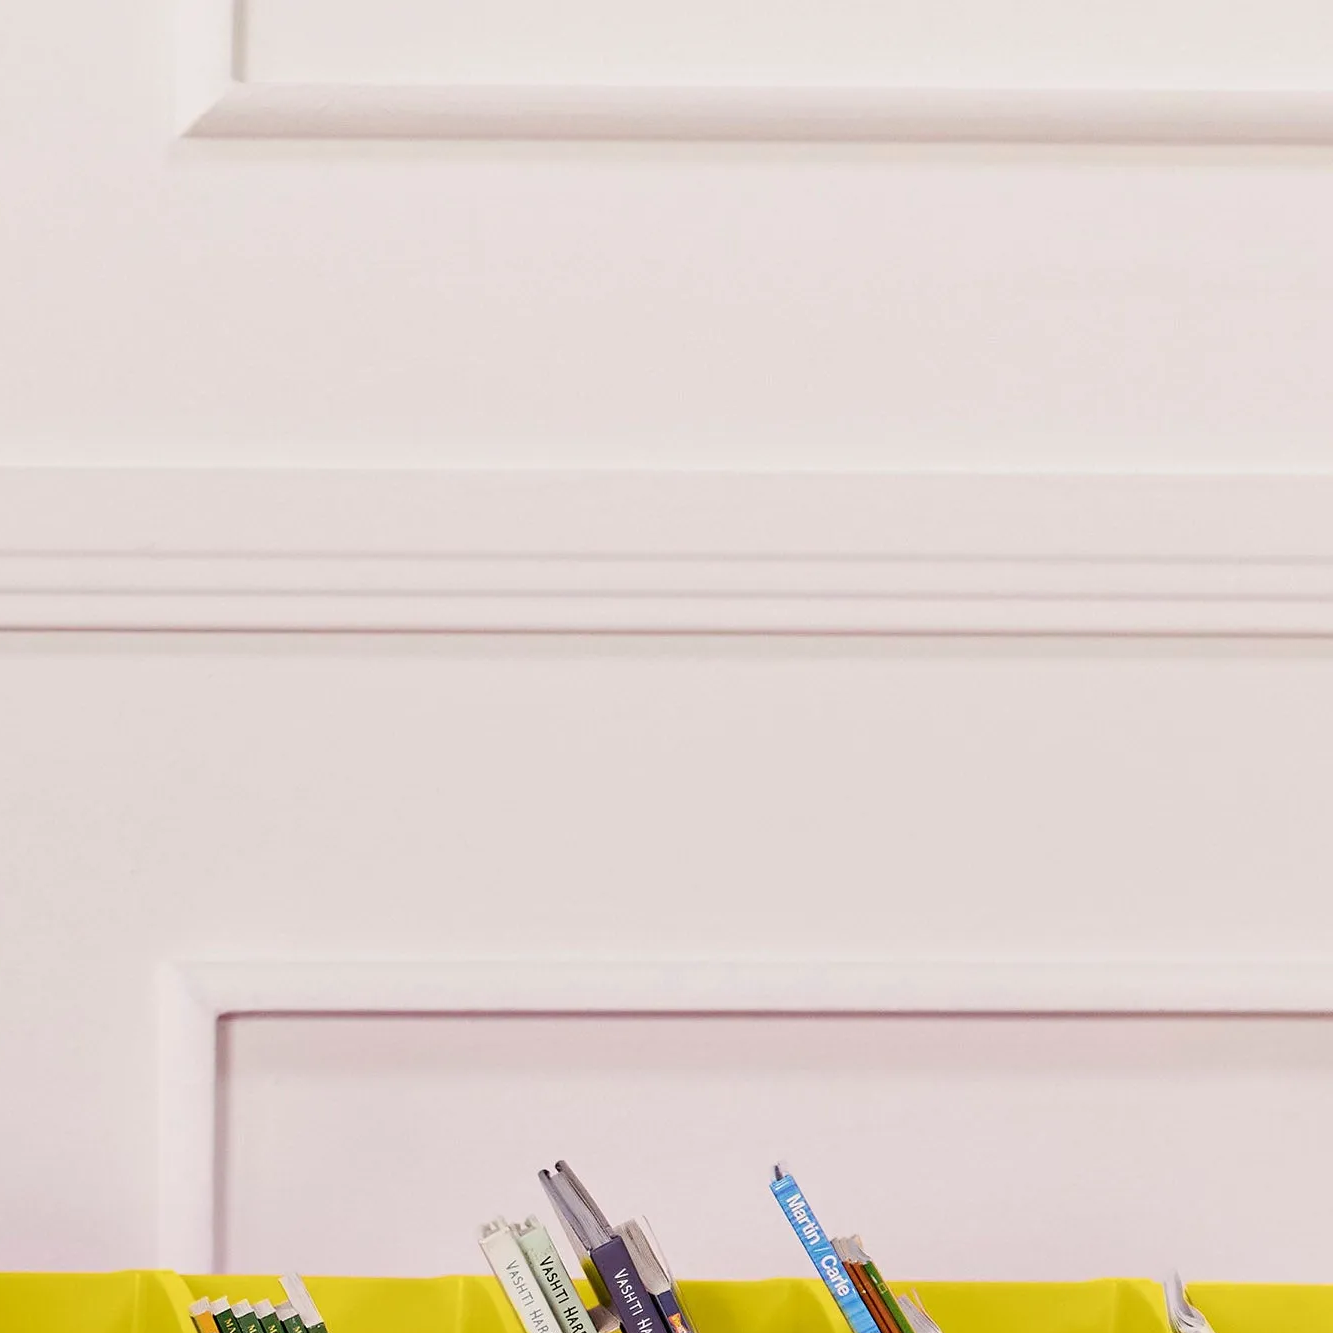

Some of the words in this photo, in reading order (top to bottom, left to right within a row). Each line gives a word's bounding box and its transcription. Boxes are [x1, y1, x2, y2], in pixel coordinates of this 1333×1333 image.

[787, 1193, 821, 1246] Martin
[820, 1254, 850, 1297] Carle
[506, 1260, 533, 1308] VASHTI
[539, 1256, 569, 1304] VASHTI
[614, 1268, 644, 1317] VASHTI
